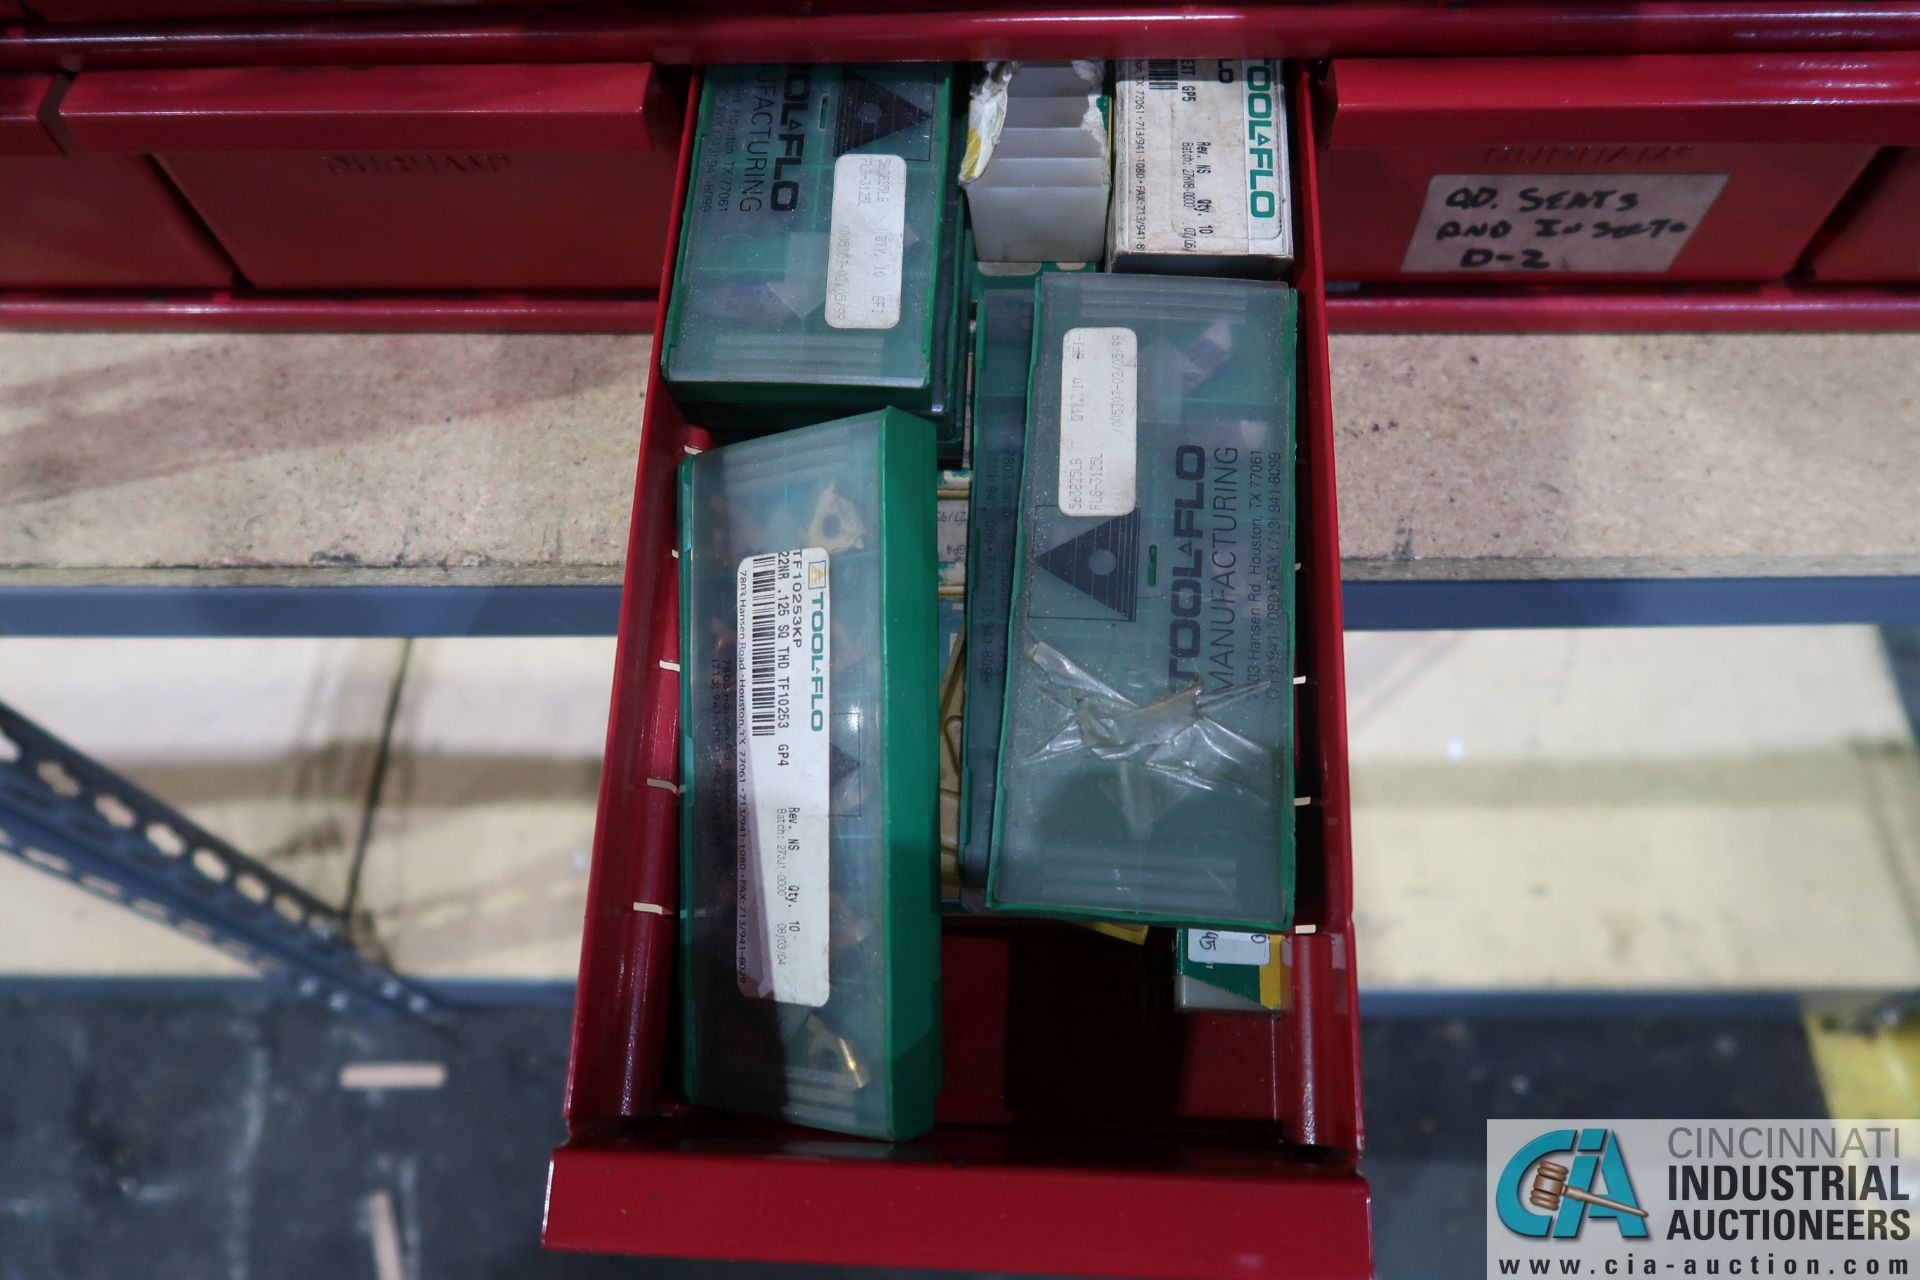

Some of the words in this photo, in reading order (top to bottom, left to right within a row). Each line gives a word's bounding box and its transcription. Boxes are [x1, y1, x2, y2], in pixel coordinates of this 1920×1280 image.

[1135, 90, 1146, 114] 77061
[1182, 85, 1196, 102] GP5
[1196, 141, 1212, 158] Rev.
[1196, 164, 1212, 174] NS
[1194, 199, 1213, 216] Qty.
[1198, 225, 1214, 234] 10
[1249, 449, 1264, 489] 77061
[1249, 494, 1264, 511] TX
[778, 551, 790, 580] 22NR
[777, 589, 790, 617] .125
[738, 599, 747, 642] Hansen
[777, 624, 790, 639] SQ
[738, 642, 747, 670] Road
[778, 646, 790, 669] THD
[778, 676, 790, 729] TF10253
[738, 751, 747, 783] 77061
[777, 744, 790, 767] GP4
[776, 808, 788, 839] Batch:
[787, 807, 801, 829] Rev.
[787, 838, 801, 851] NS
[785, 885, 800, 908] Qty.
[787, 920, 801, 932] 10
